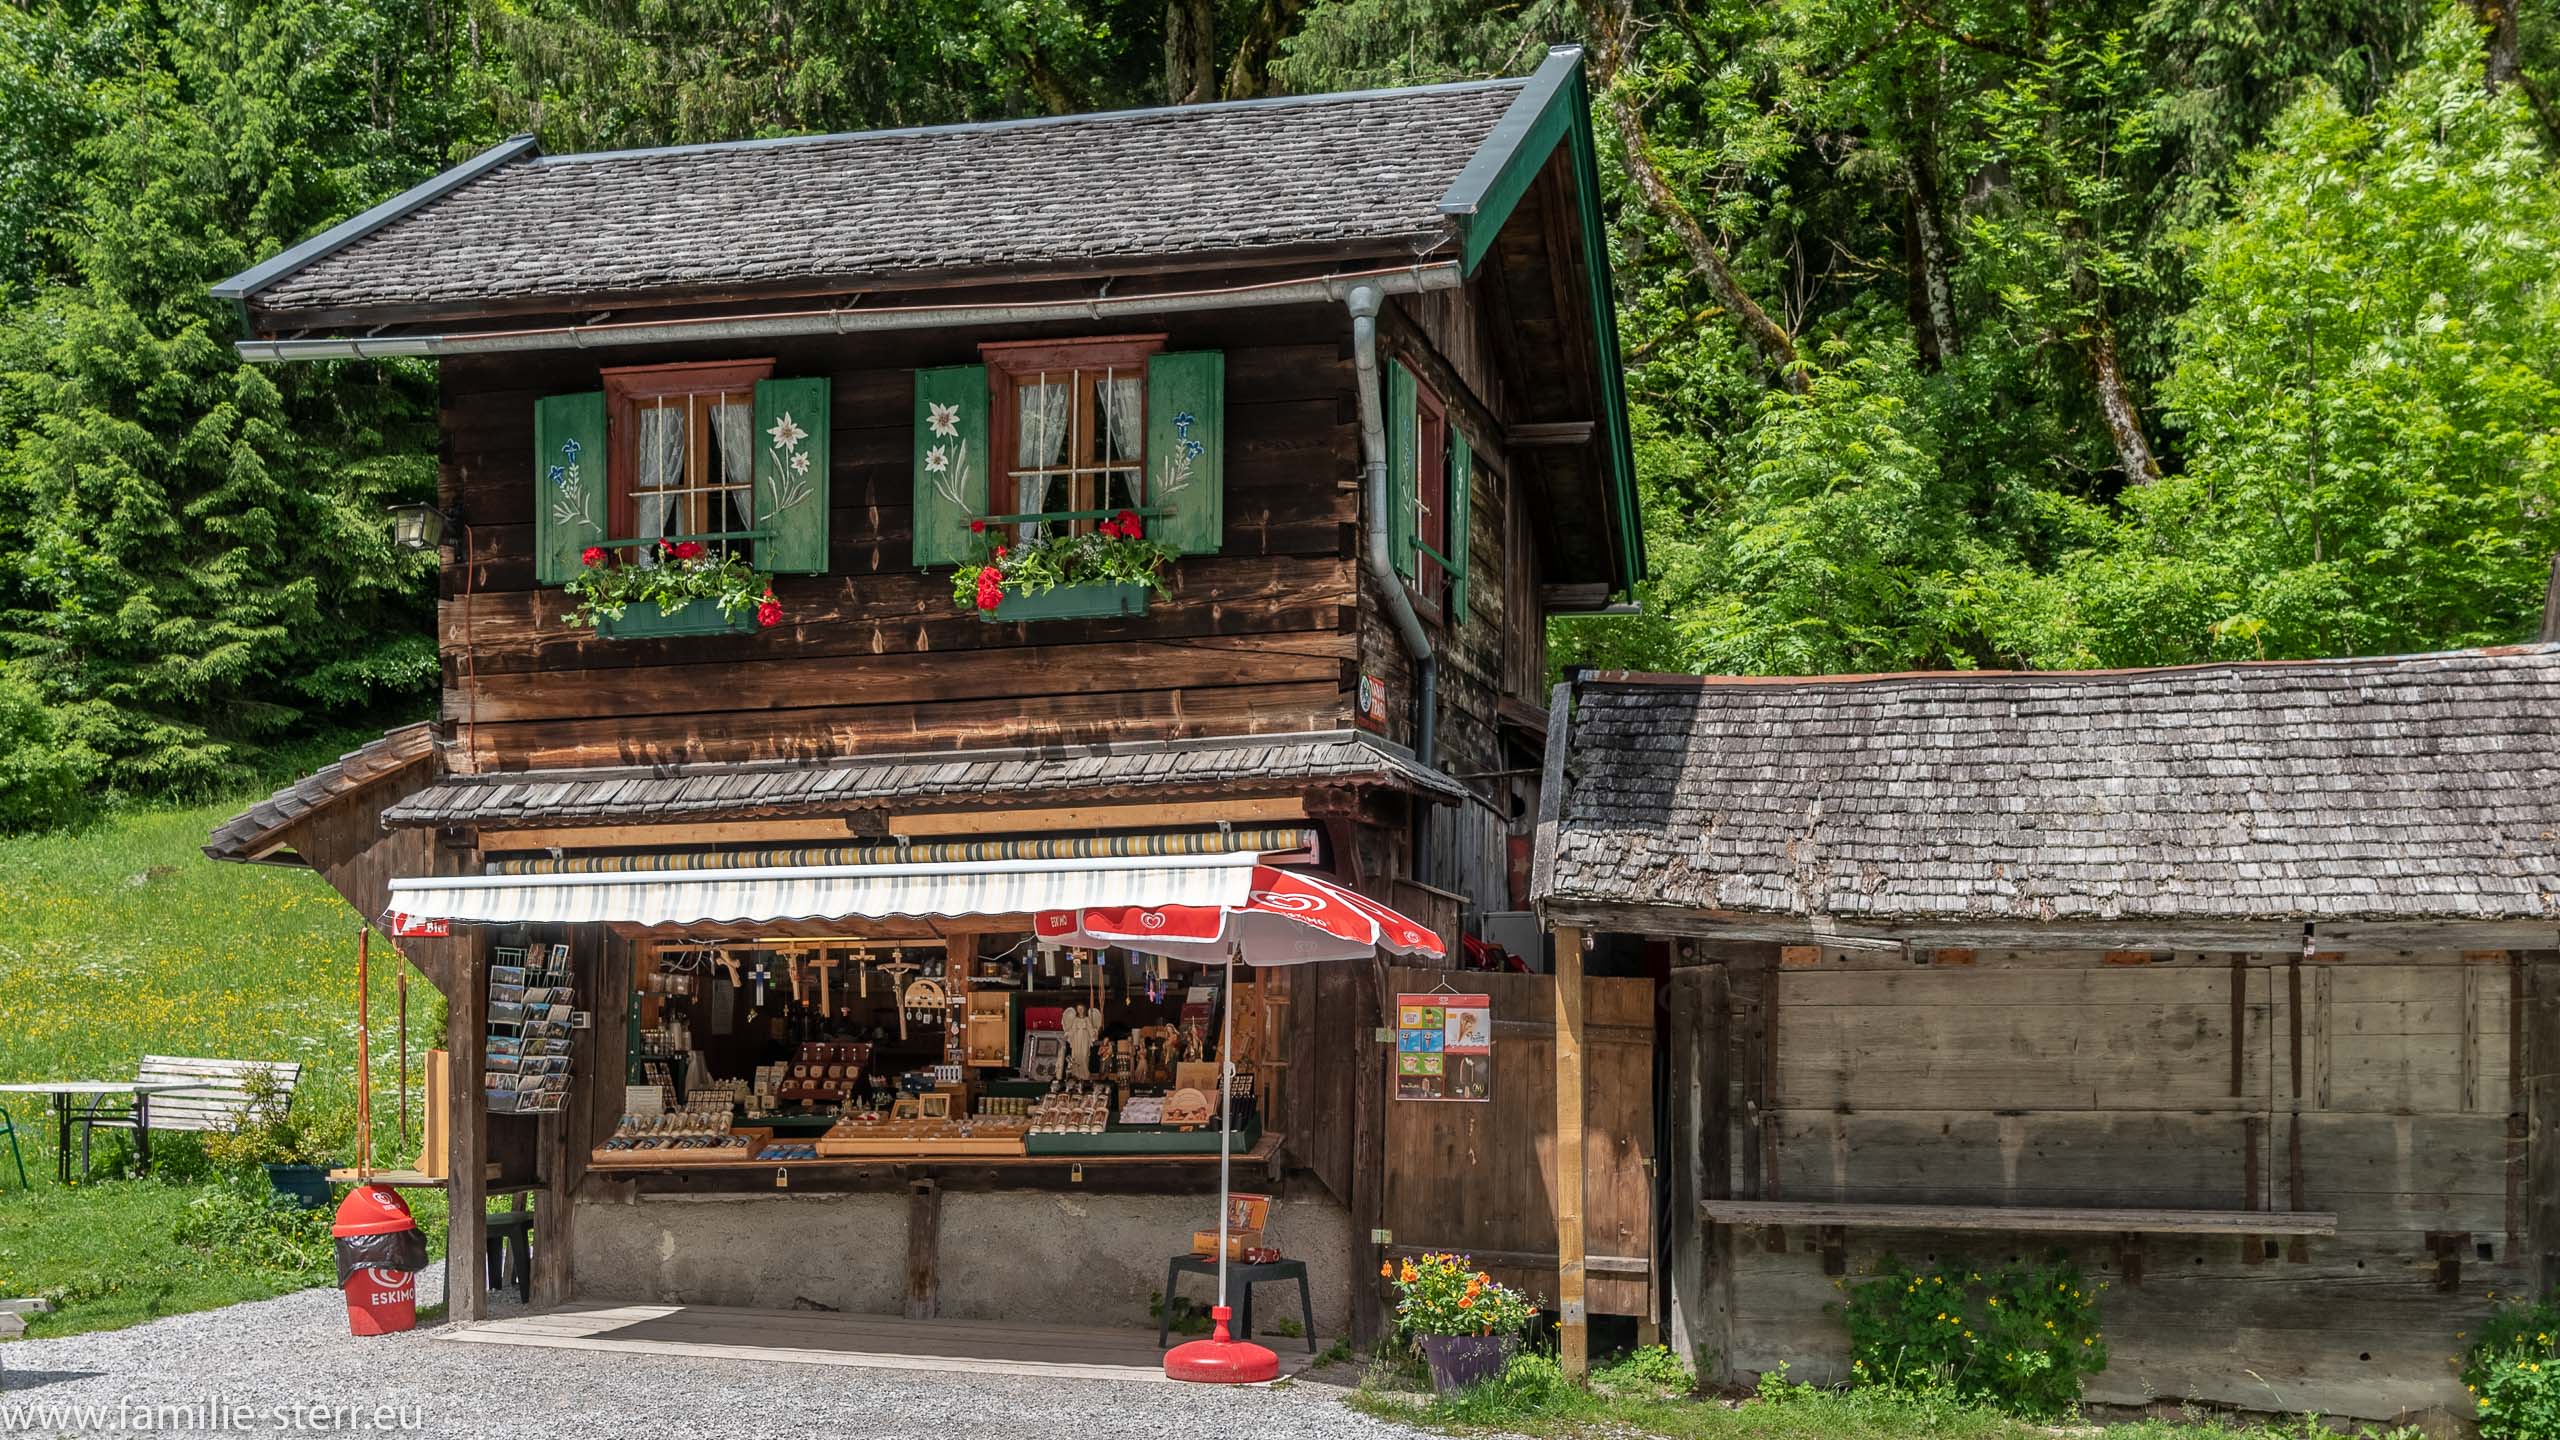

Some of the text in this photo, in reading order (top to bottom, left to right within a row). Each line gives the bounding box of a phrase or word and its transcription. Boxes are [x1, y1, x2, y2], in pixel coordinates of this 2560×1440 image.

[424, 921, 448, 934] Bier
[1050, 914, 1068, 928] ESKMO
[371, 1288, 414, 1305] ESKIMO
